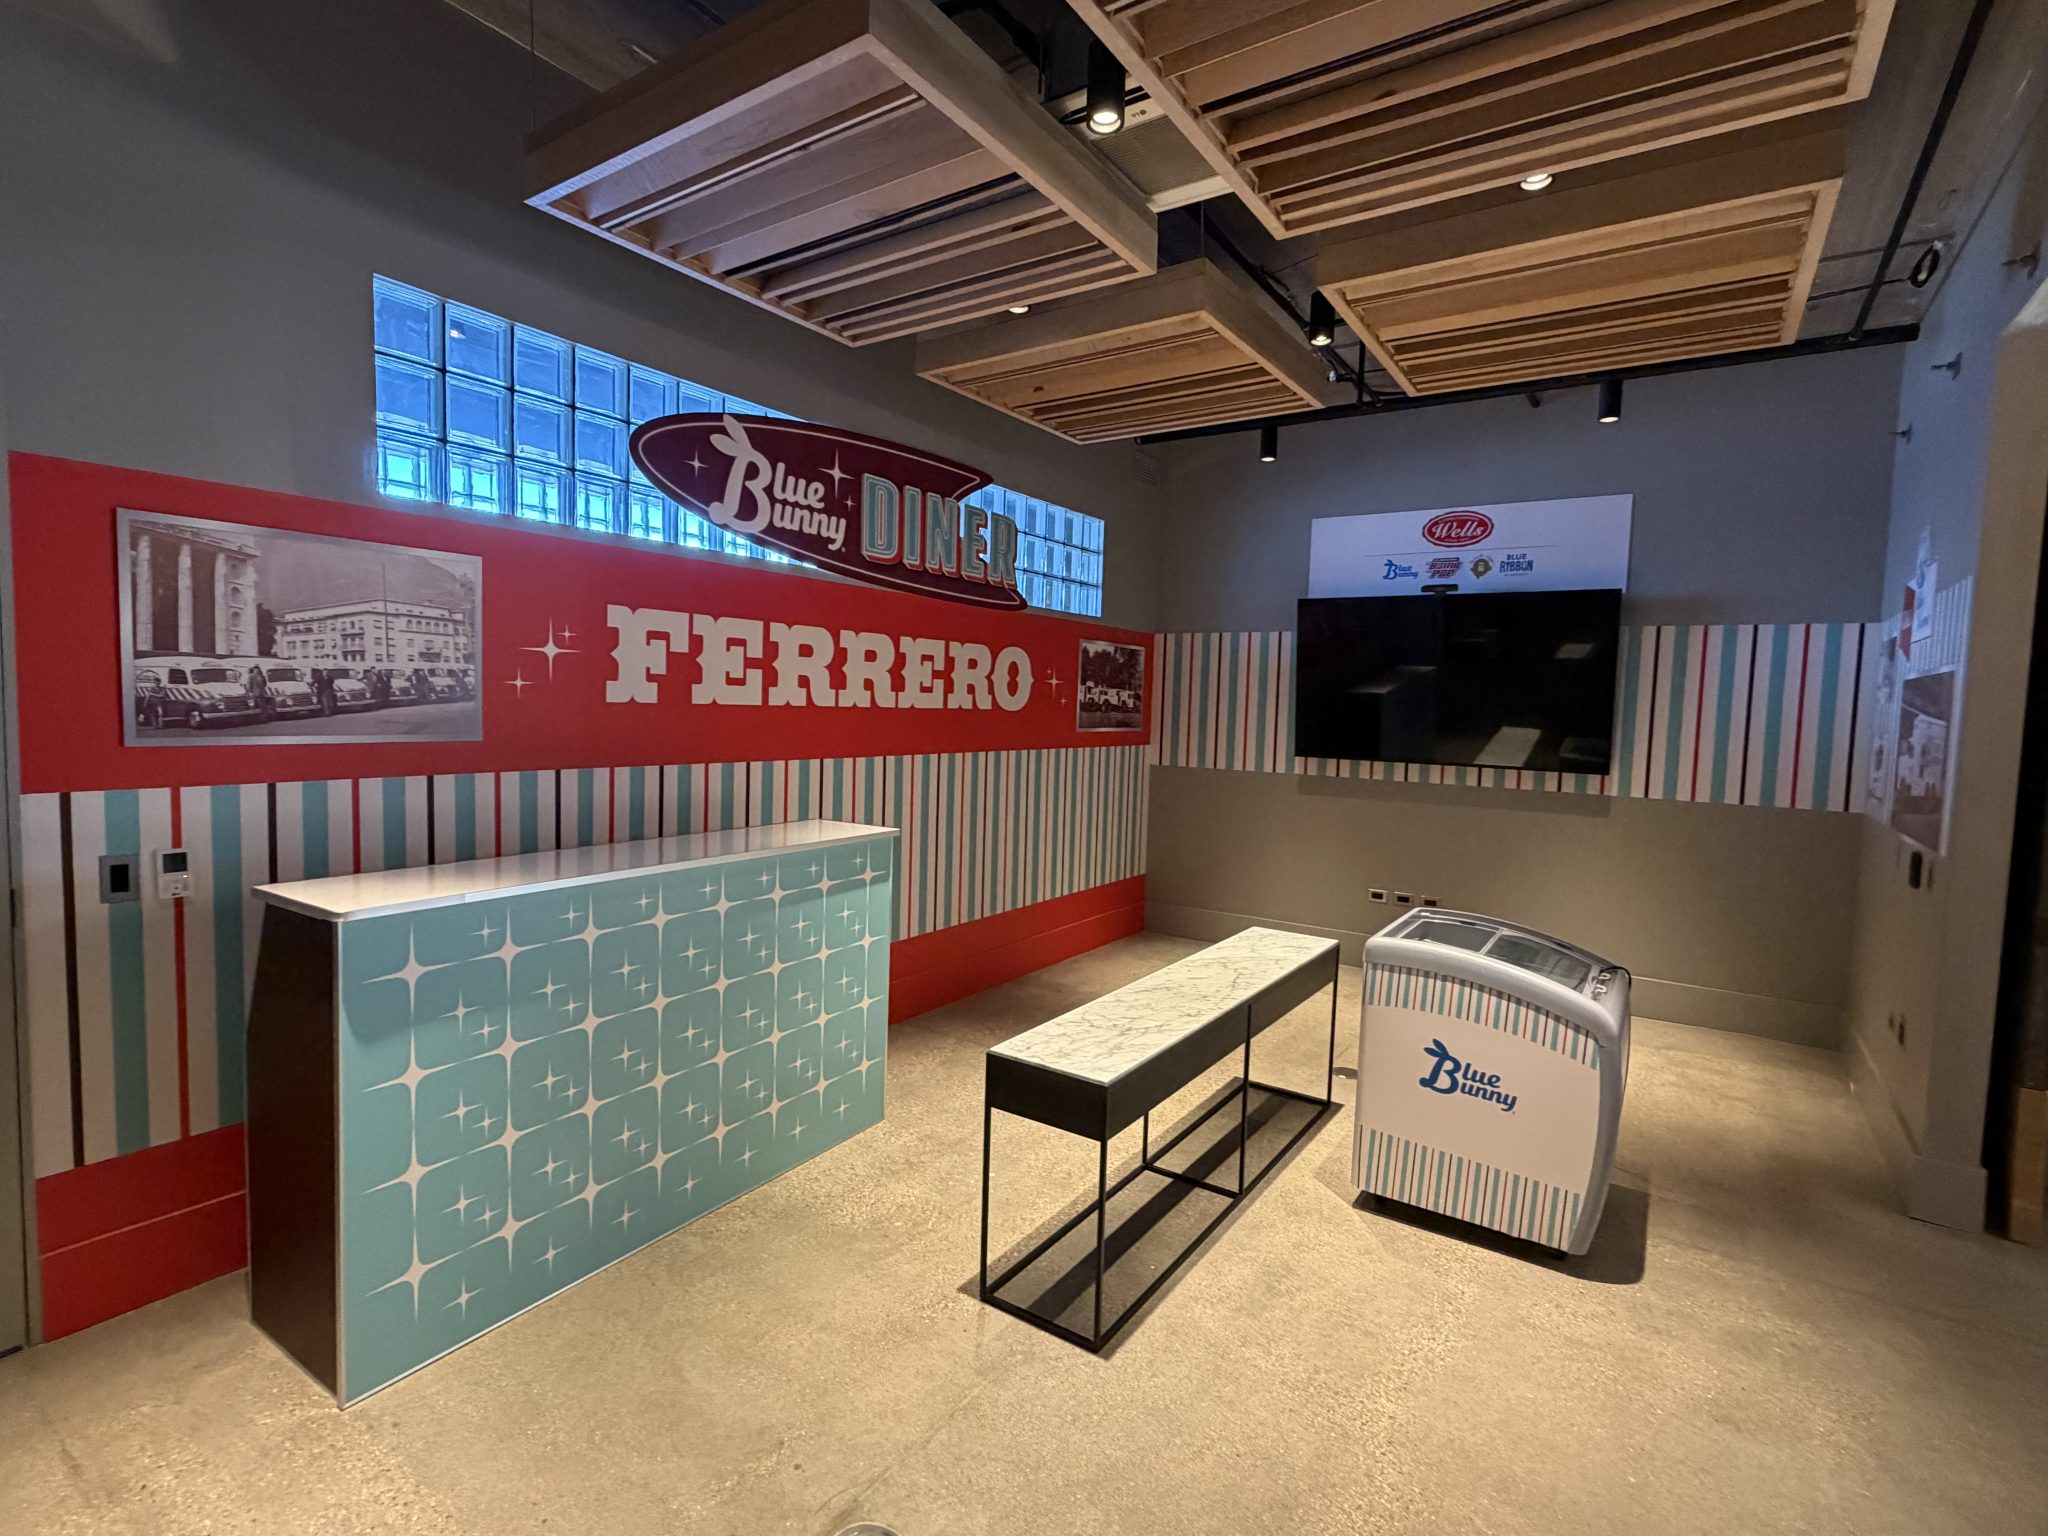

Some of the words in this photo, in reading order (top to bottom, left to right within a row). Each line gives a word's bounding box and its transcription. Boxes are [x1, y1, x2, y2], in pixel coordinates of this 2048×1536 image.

[709, 414, 824, 533] Blue
[709, 452, 847, 551] Bunny
[861, 473, 1018, 588] DINER
[1432, 521, 1486, 538] Wells
[1500, 560, 1533, 572] RIBBON
[606, 604, 1034, 711] FERRERO
[1420, 1038, 1501, 1094] Blue
[1420, 1053, 1517, 1112] Bunny
